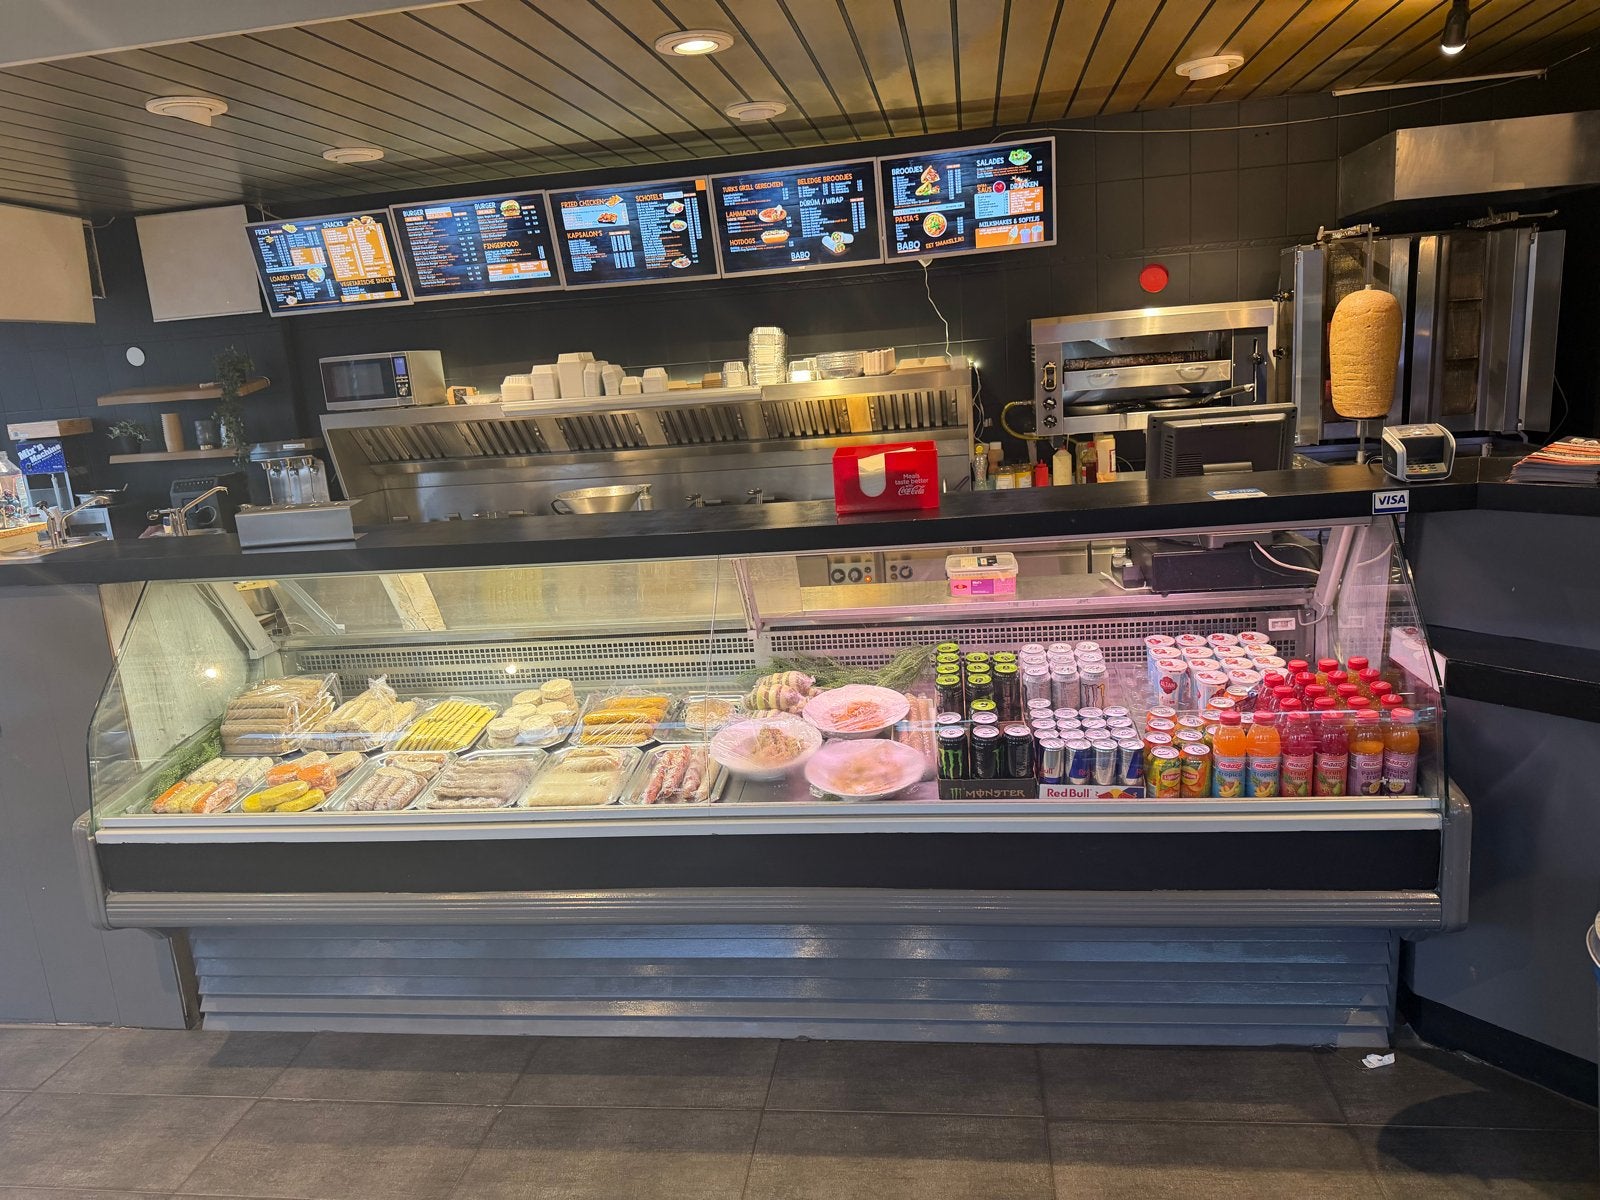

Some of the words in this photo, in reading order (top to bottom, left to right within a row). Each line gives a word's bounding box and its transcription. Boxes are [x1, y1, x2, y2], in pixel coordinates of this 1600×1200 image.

[976, 157, 1004, 167] SALADES
[892, 166, 923, 176] BROODJES
[823, 173, 853, 182] BROODJES
[754, 181, 783, 190] GERECHTEN
[1010, 180, 1039, 190] DRANKEN
[636, 194, 663, 202] SCHOTELS
[474, 202, 496, 210] BURGER
[403, 209, 424, 217] BURGER
[726, 209, 758, 217] LAHMACUN
[895, 214, 920, 223] PASTA'S
[979, 218, 1013, 228] MILKSHAKES
[567, 230, 603, 239] KAPSALON'S
[483, 240, 519, 249] FINGERFOOD
[730, 238, 756, 246] HOTDOGS
[897, 240, 920, 250] BABO
[791, 251, 810, 259] BABO
[270, 275, 290, 283] LOADED
[290, 273, 306, 281] FRIES
[340, 279, 376, 287] VEGETARISCHE
[18, 443, 44, 460] Mix'n
[29, 444, 62, 463] Machine
[1378, 495, 1406, 505] VISA
[966, 789, 1026, 798] MONSTER
[1047, 789, 1068, 797] Red
[1069, 789, 1089, 797] Bull
